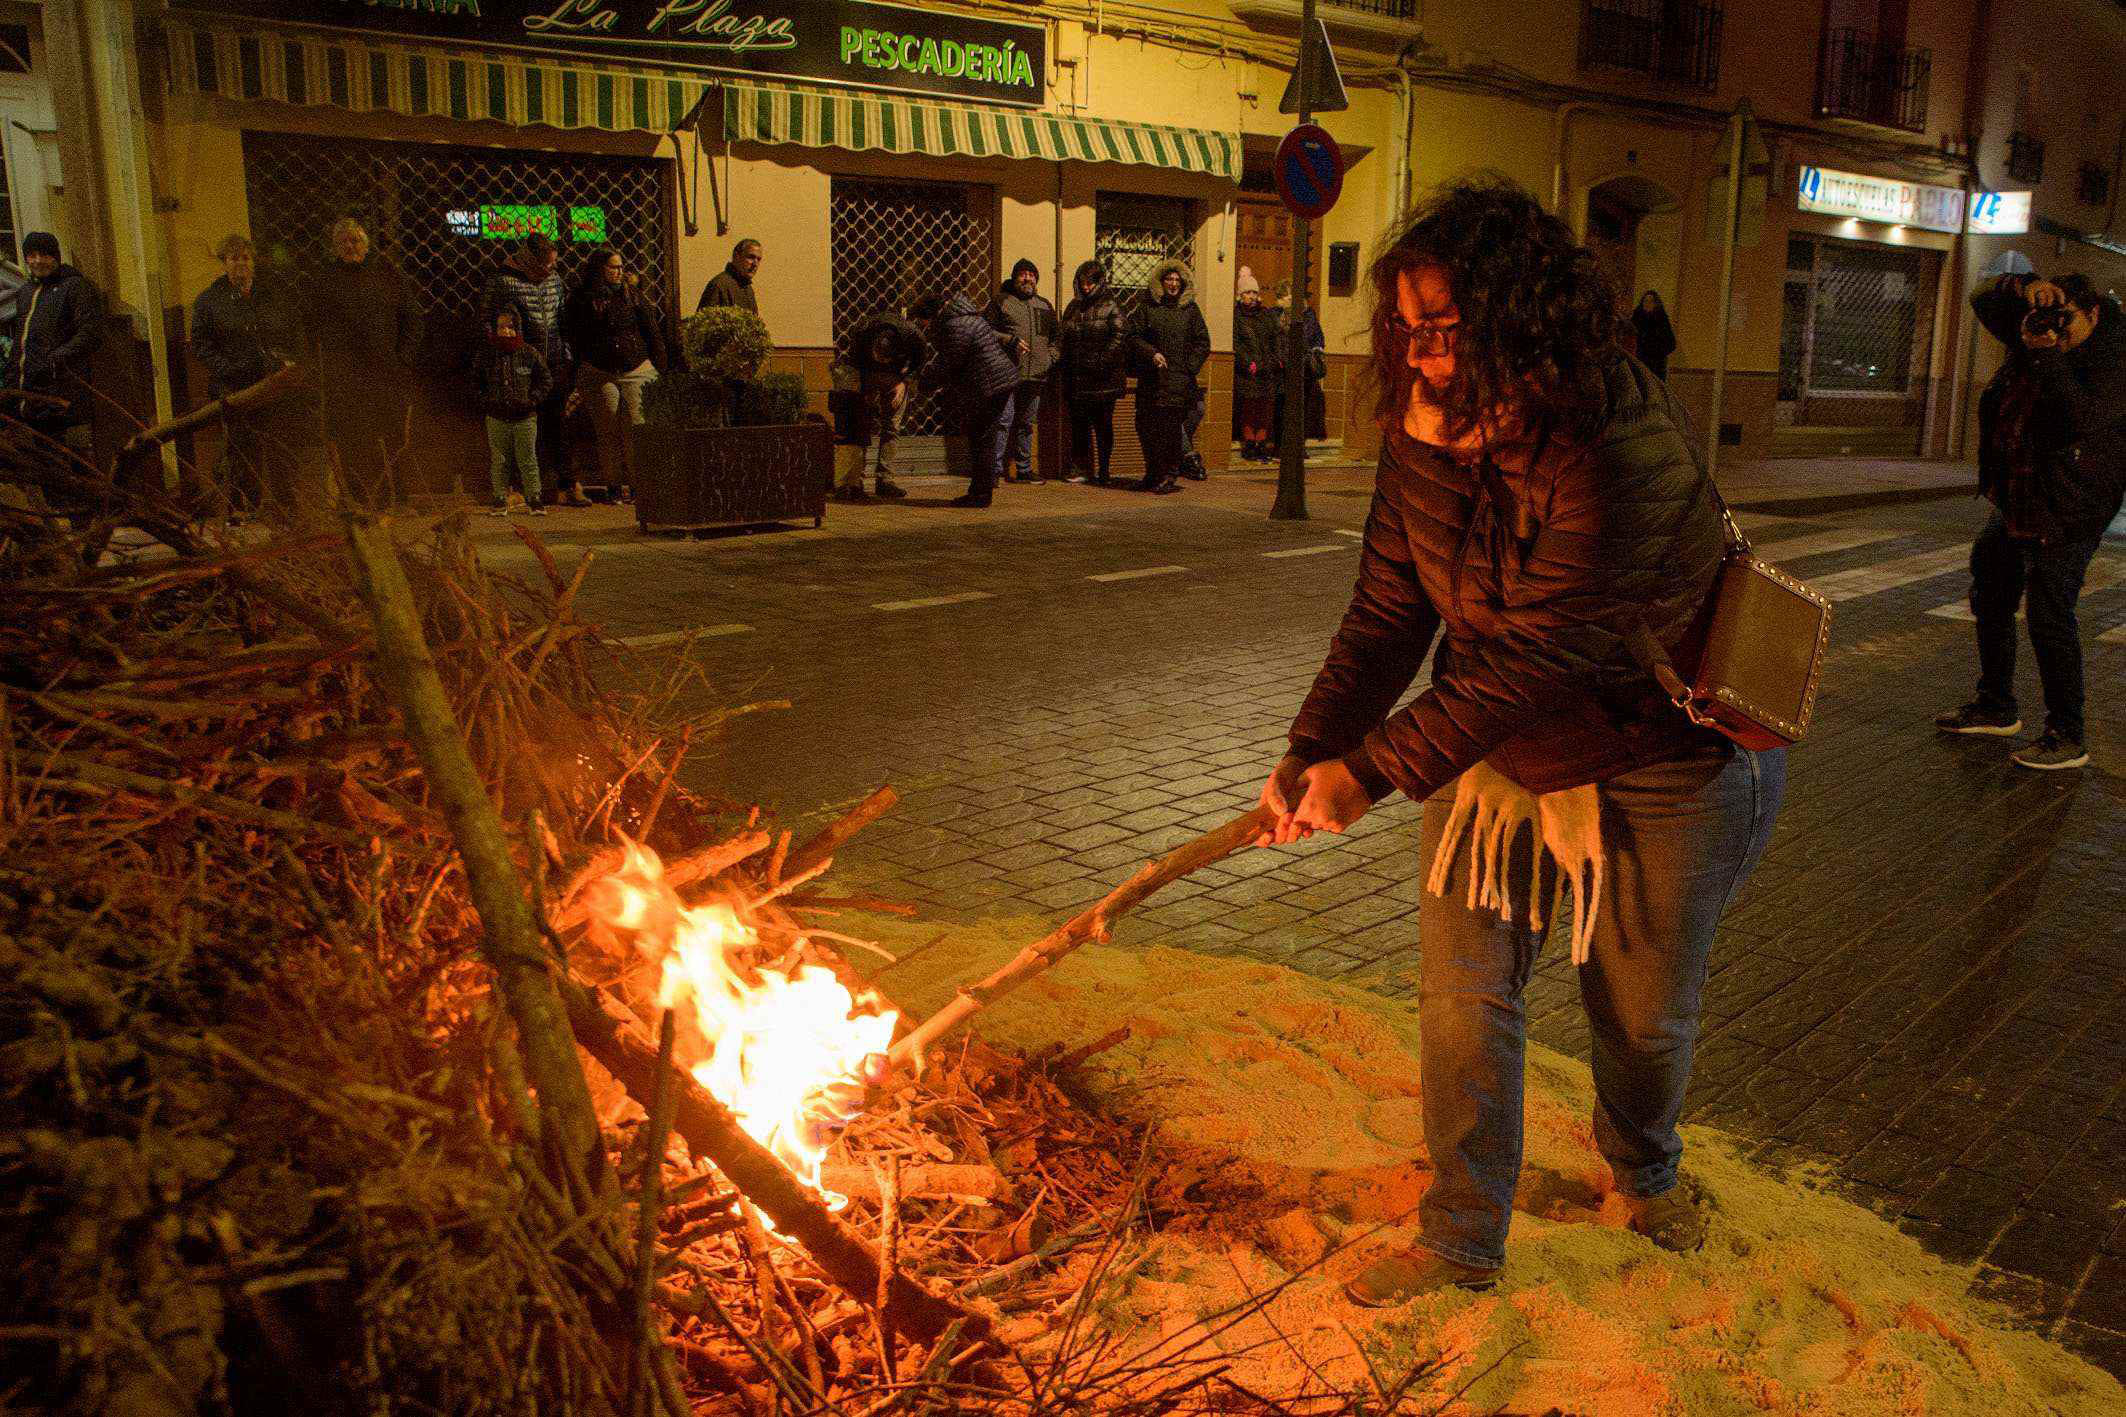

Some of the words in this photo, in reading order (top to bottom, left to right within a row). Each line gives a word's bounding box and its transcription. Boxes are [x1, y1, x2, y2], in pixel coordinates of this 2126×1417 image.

[522, 0, 618, 31] La
[645, 0, 797, 51] Plaza
[840, 25, 1035, 88] PESCADERÍA
